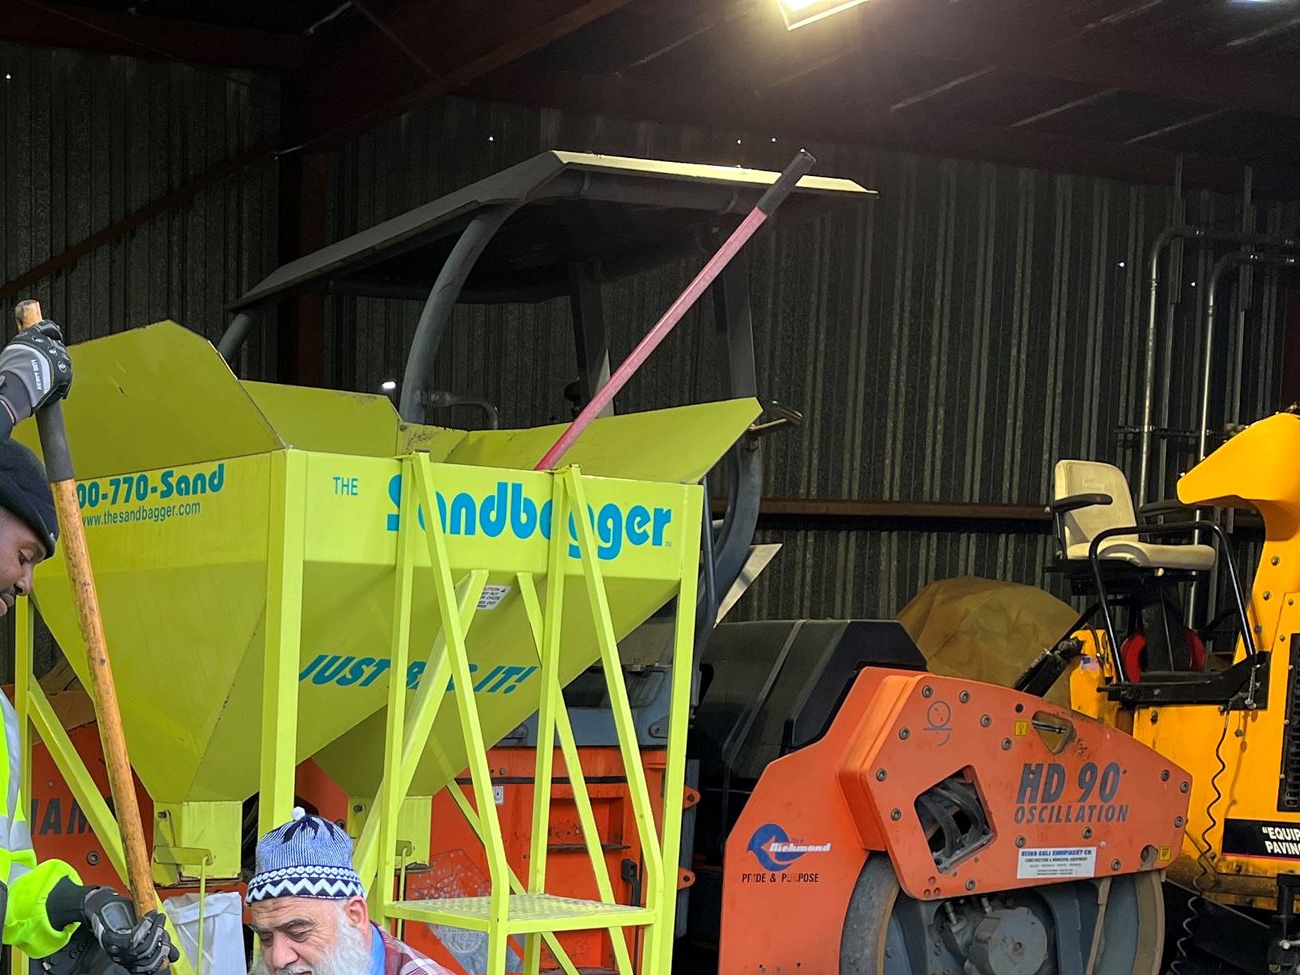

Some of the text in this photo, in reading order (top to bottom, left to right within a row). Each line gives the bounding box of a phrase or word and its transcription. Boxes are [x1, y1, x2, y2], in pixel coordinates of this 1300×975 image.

[333, 476, 359, 496] THE
[300, 655, 391, 687] JUST
[474, 666, 538, 695] IT!
[1016, 762, 1121, 804] HD 90
[1014, 805, 1128, 824] OSCILLATION
[770, 843, 831, 852] Richmond
[770, 873, 777, 882] &
[781, 873, 819, 882] PPOSE
